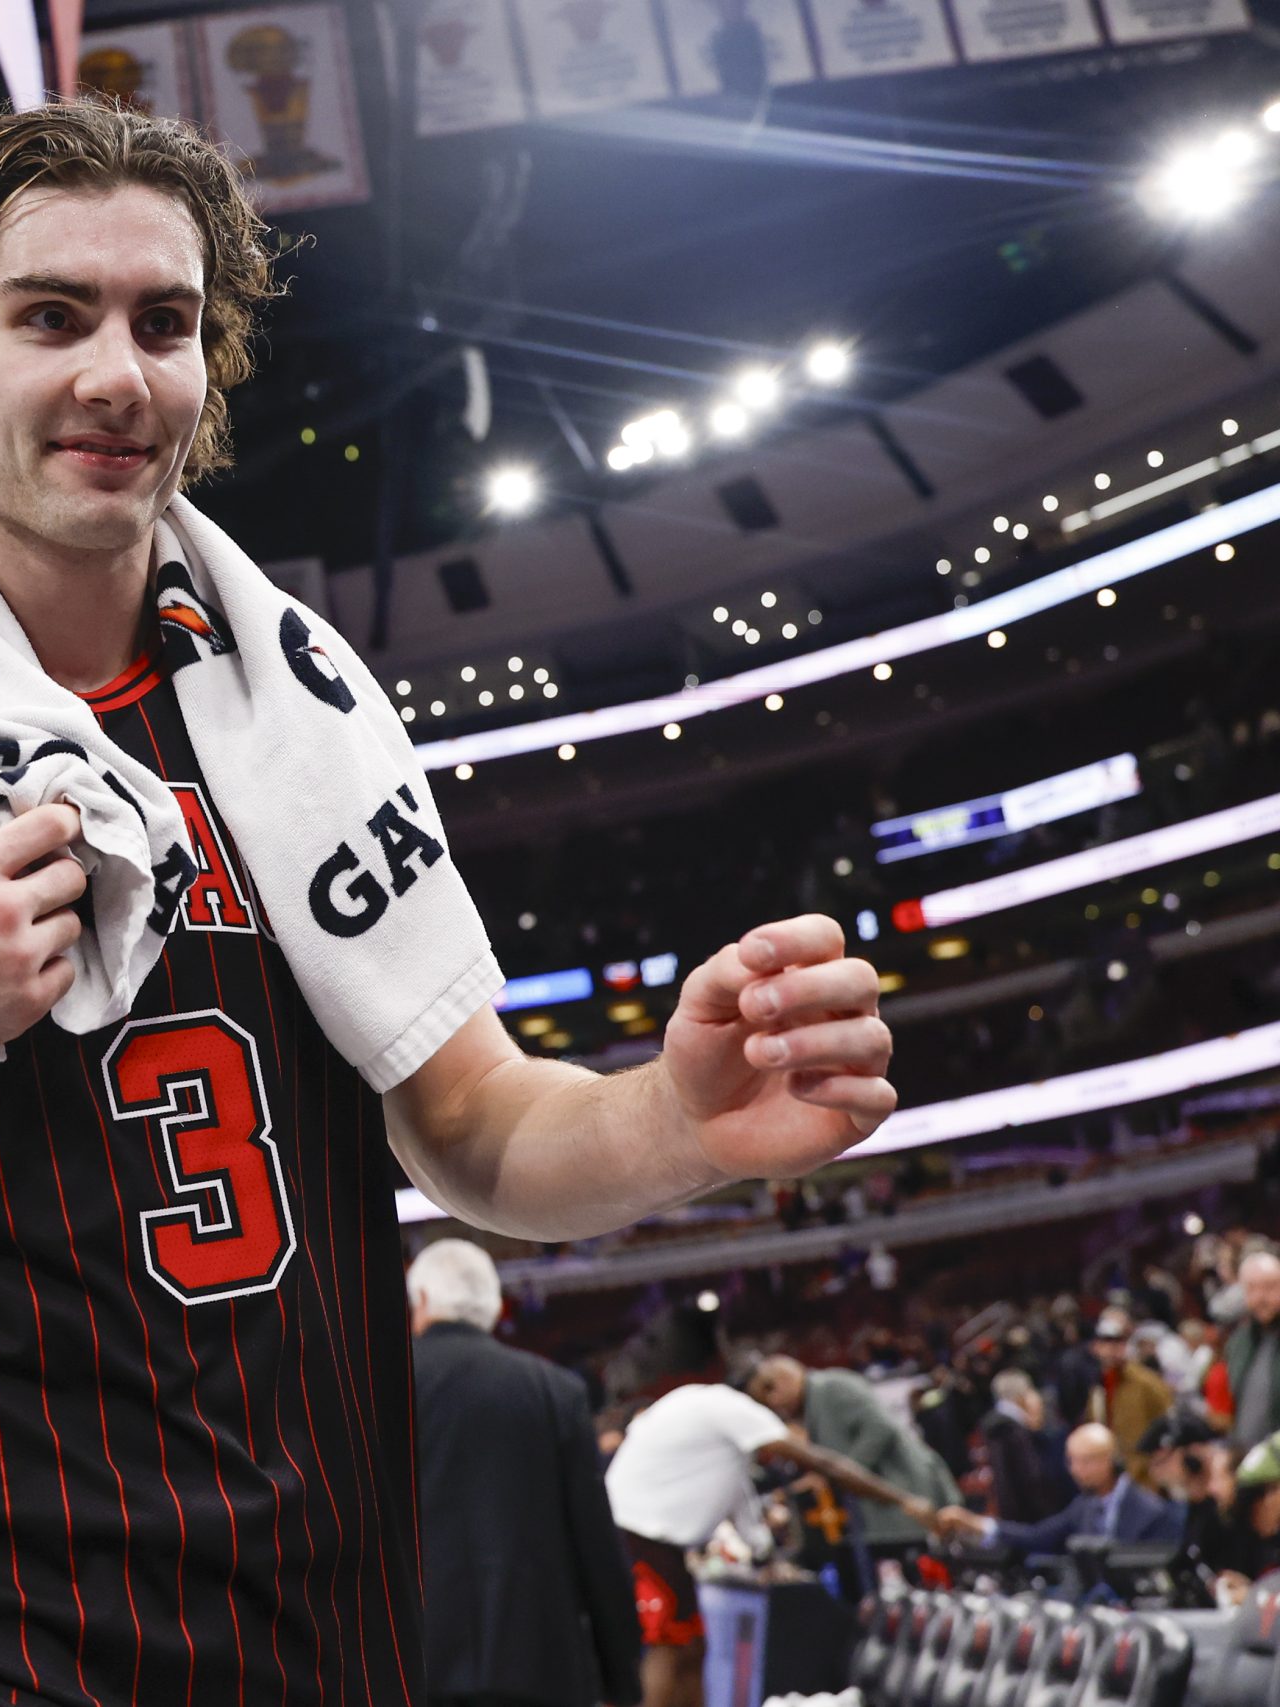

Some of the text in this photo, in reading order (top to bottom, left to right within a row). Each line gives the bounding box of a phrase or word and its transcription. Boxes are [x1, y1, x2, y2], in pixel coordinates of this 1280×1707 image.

[167, 782, 272, 938] A
[309, 783, 445, 938] GA
[101, 1008, 297, 1305] 3
